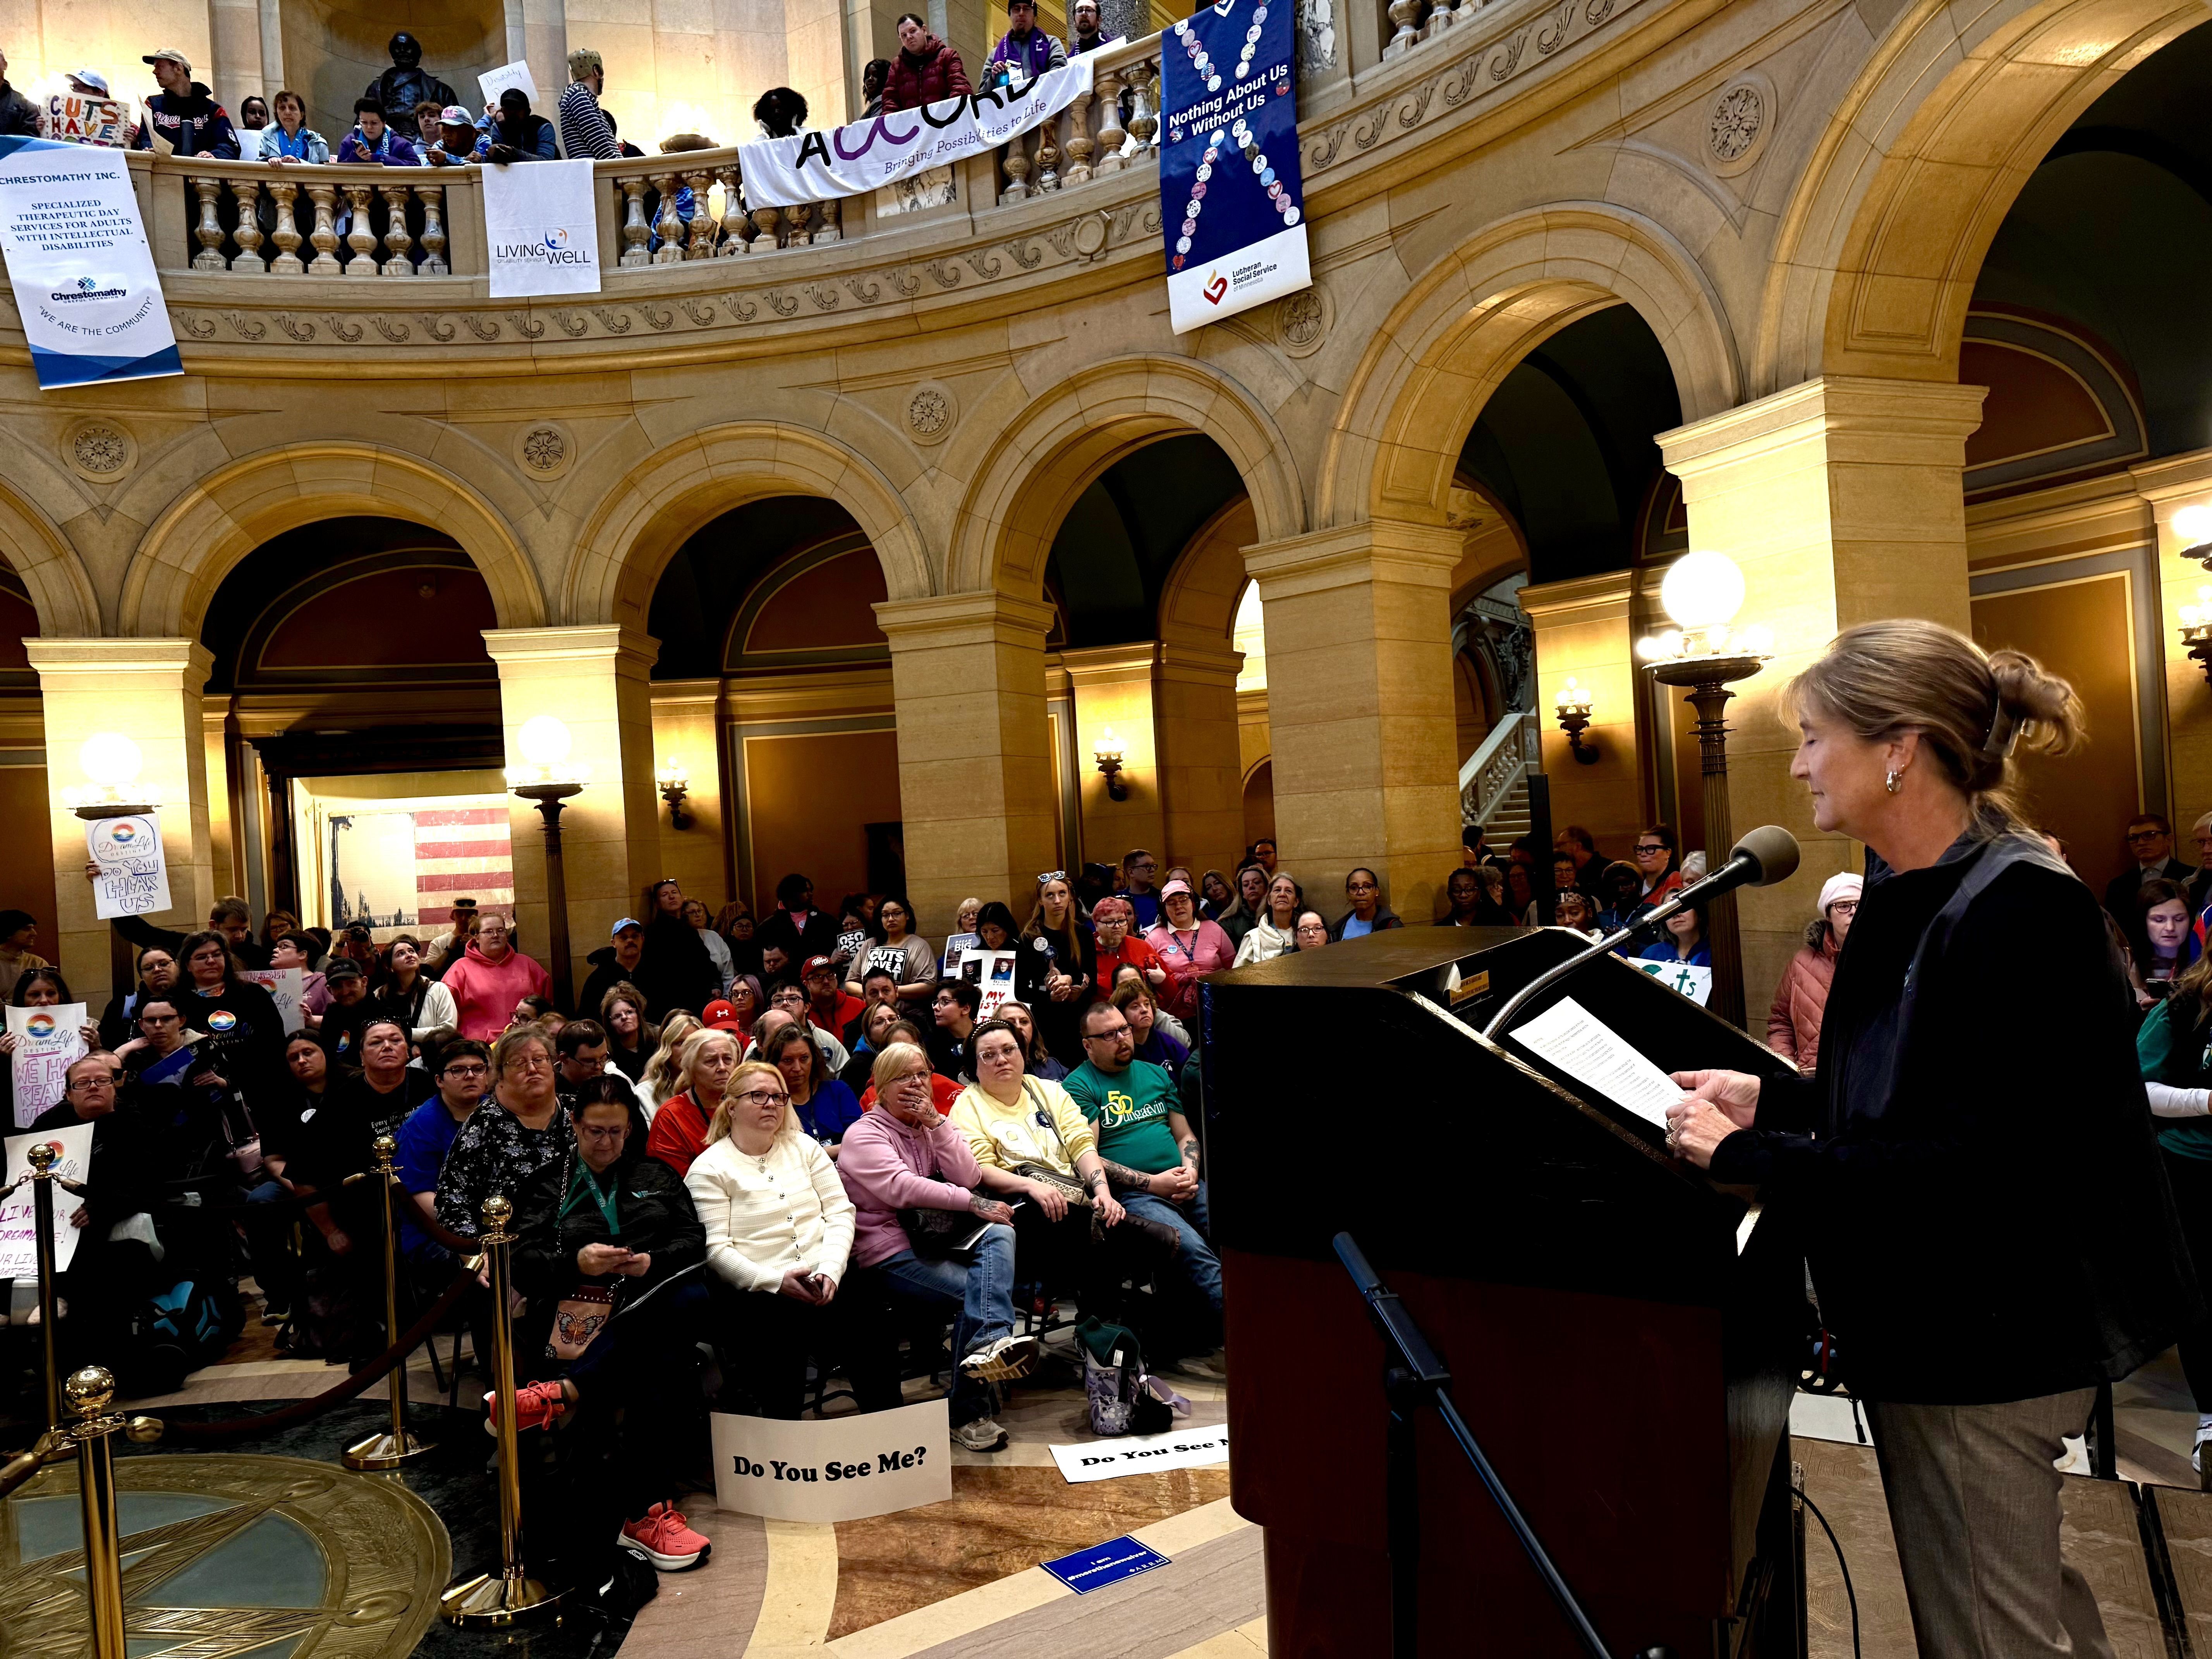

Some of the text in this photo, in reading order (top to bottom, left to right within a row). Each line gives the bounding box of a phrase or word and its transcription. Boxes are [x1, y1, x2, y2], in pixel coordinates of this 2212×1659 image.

[485, 69, 522, 86] Disability
[1169, 64, 1288, 129] Nothing About Us
[50, 95, 118, 125] CUTS
[1191, 94, 1265, 136] Without Us
[52, 117, 115, 139] HAVE
[884, 101, 1046, 175] Bringing Possibilities to Life
[0, 172, 120, 185] CHRESTOMATHY INC.
[31, 199, 101, 210] SPECIALIZED
[17, 210, 96, 221] THERAPEUTIC
[10, 222, 63, 231] SERVICES
[91, 218, 132, 227] ADULTS
[15, 228, 133, 242] WITH INTELLECTUAL
[42, 240, 113, 251] DISABILITIES
[497, 243, 545, 257] LIVING
[1233, 262, 1261, 278] Lutheran
[1233, 264, 1277, 285] Social Service
[1239, 277, 1263, 290] Minnesota
[51, 288, 127, 301] Chrestomathy
[40, 306, 56, 323] "WE
[57, 321, 78, 333] ARE
[106, 296, 153, 334] COMMUNITY"
[100, 859, 158, 880] DO YOU
[105, 875, 158, 898] HEAR
[120, 893, 154, 913] US
[954, 942, 972, 952] BIG
[869, 950, 905, 963] CUTS
[867, 961, 902, 971] HAVE A
[986, 991, 1005, 1001] MY
[14, 1058, 40, 1084] WE
[1108, 1091, 1133, 1115] 50
[1101, 1101, 1165, 1128] Dungarvin
[371, 1120, 387, 1128] Every
[0, 1206, 35, 1222] LIVE
[15, 1254, 38, 1264] LIVE
[1080, 1457, 1115, 1466] Do
[1120, 1448, 1169, 1460] You
[1173, 1443, 1215, 1452] See
[733, 1446, 926, 1482] Do You See Me?
[1067, 1551, 1147, 1581] #morethanawaiver
[1135, 1558, 1164, 1571] ARRM
